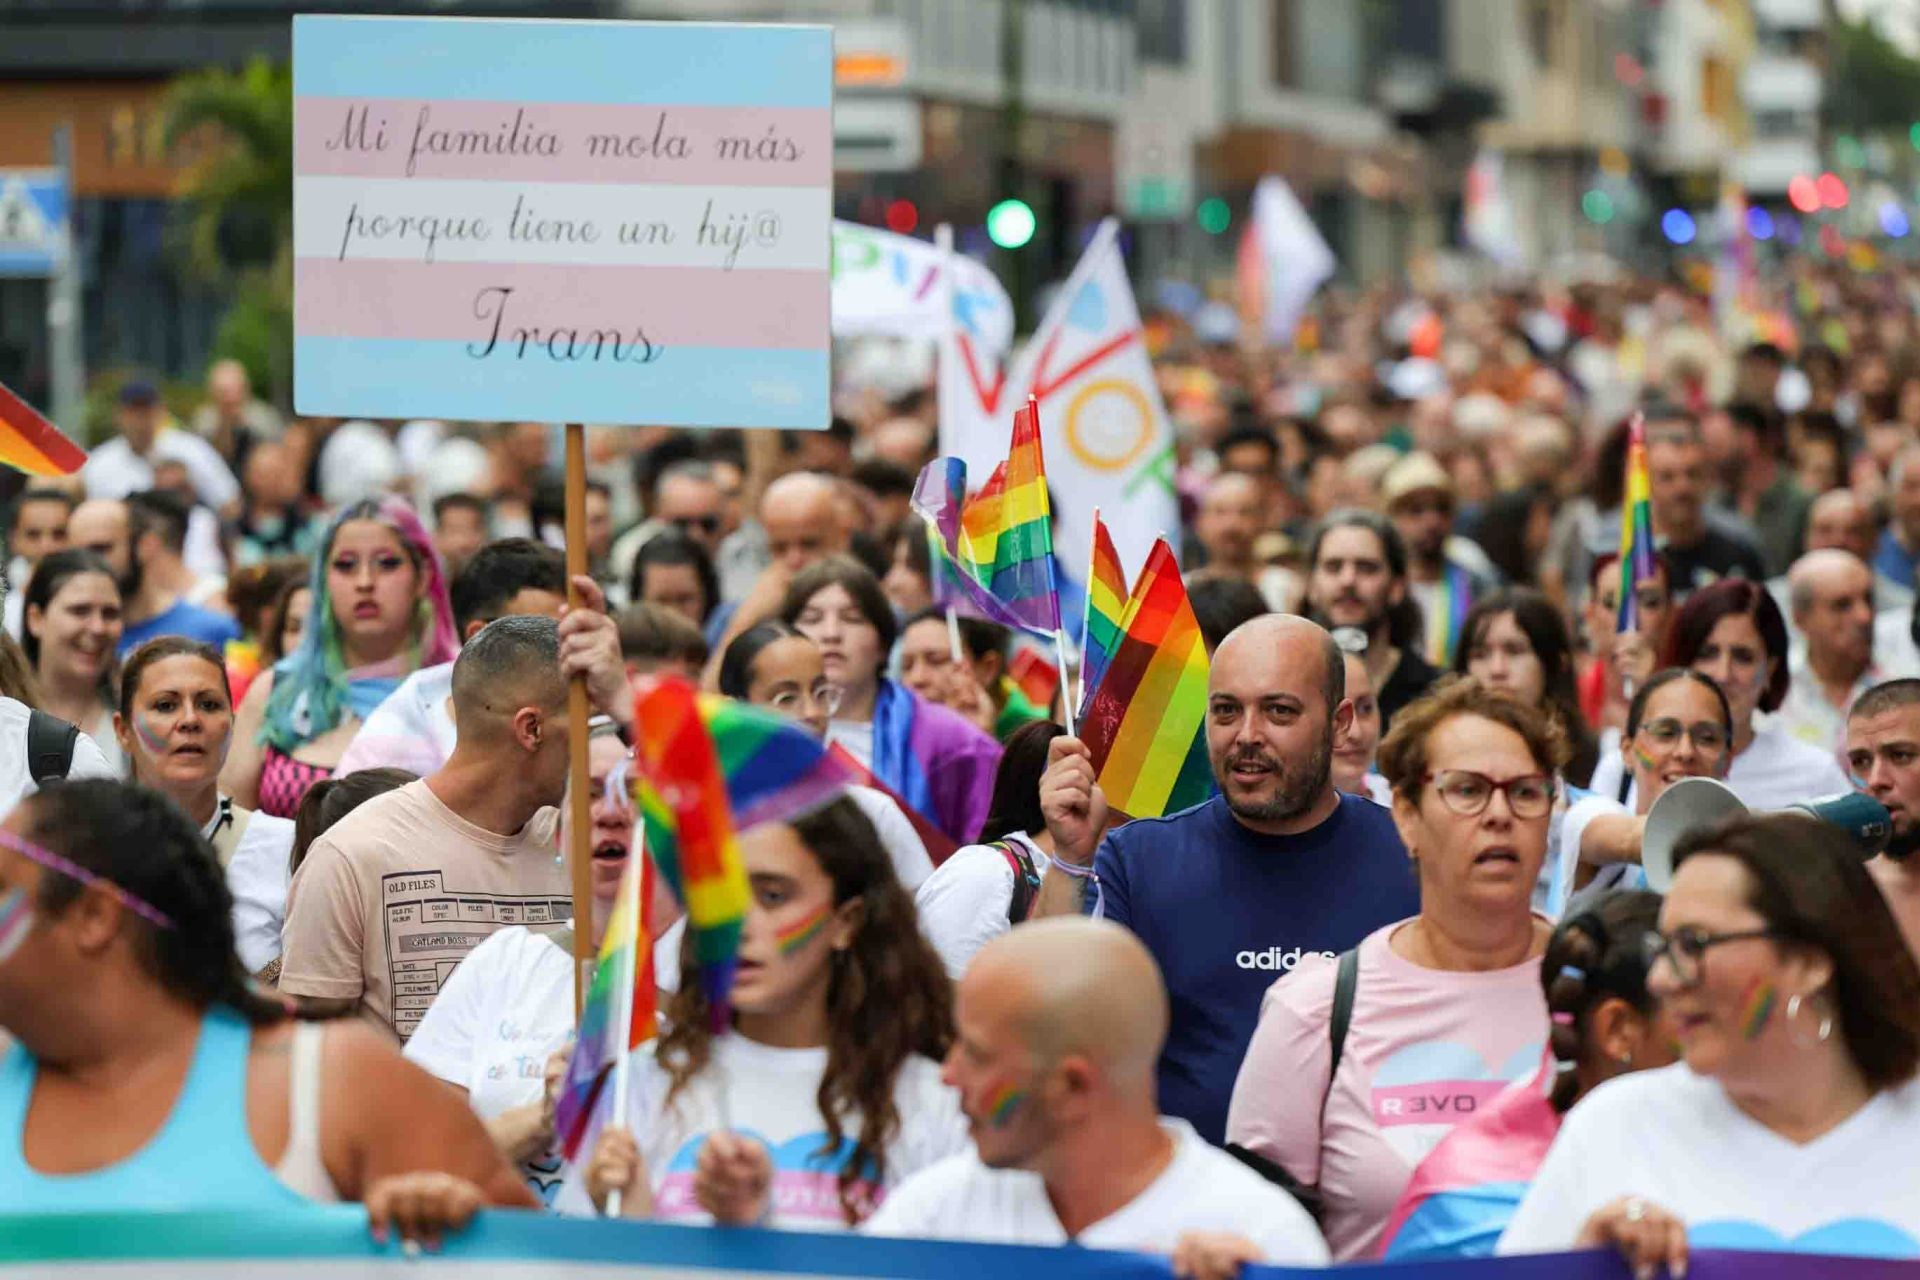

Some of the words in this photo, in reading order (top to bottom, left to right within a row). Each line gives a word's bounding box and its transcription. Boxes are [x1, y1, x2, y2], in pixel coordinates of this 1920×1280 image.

[325, 104, 389, 151] Mi
[404, 104, 563, 177] familia
[585, 111, 693, 160] mola
[713, 123, 803, 162] más
[338, 203, 491, 264] porque
[508, 194, 600, 242] tiene
[617, 219, 676, 245] un
[696, 198, 782, 272] hij@
[466, 286, 665, 364] Trans
[389, 881, 406, 893] OLD
[408, 879, 436, 891] FILES
[447, 936, 467, 945] BOSS
